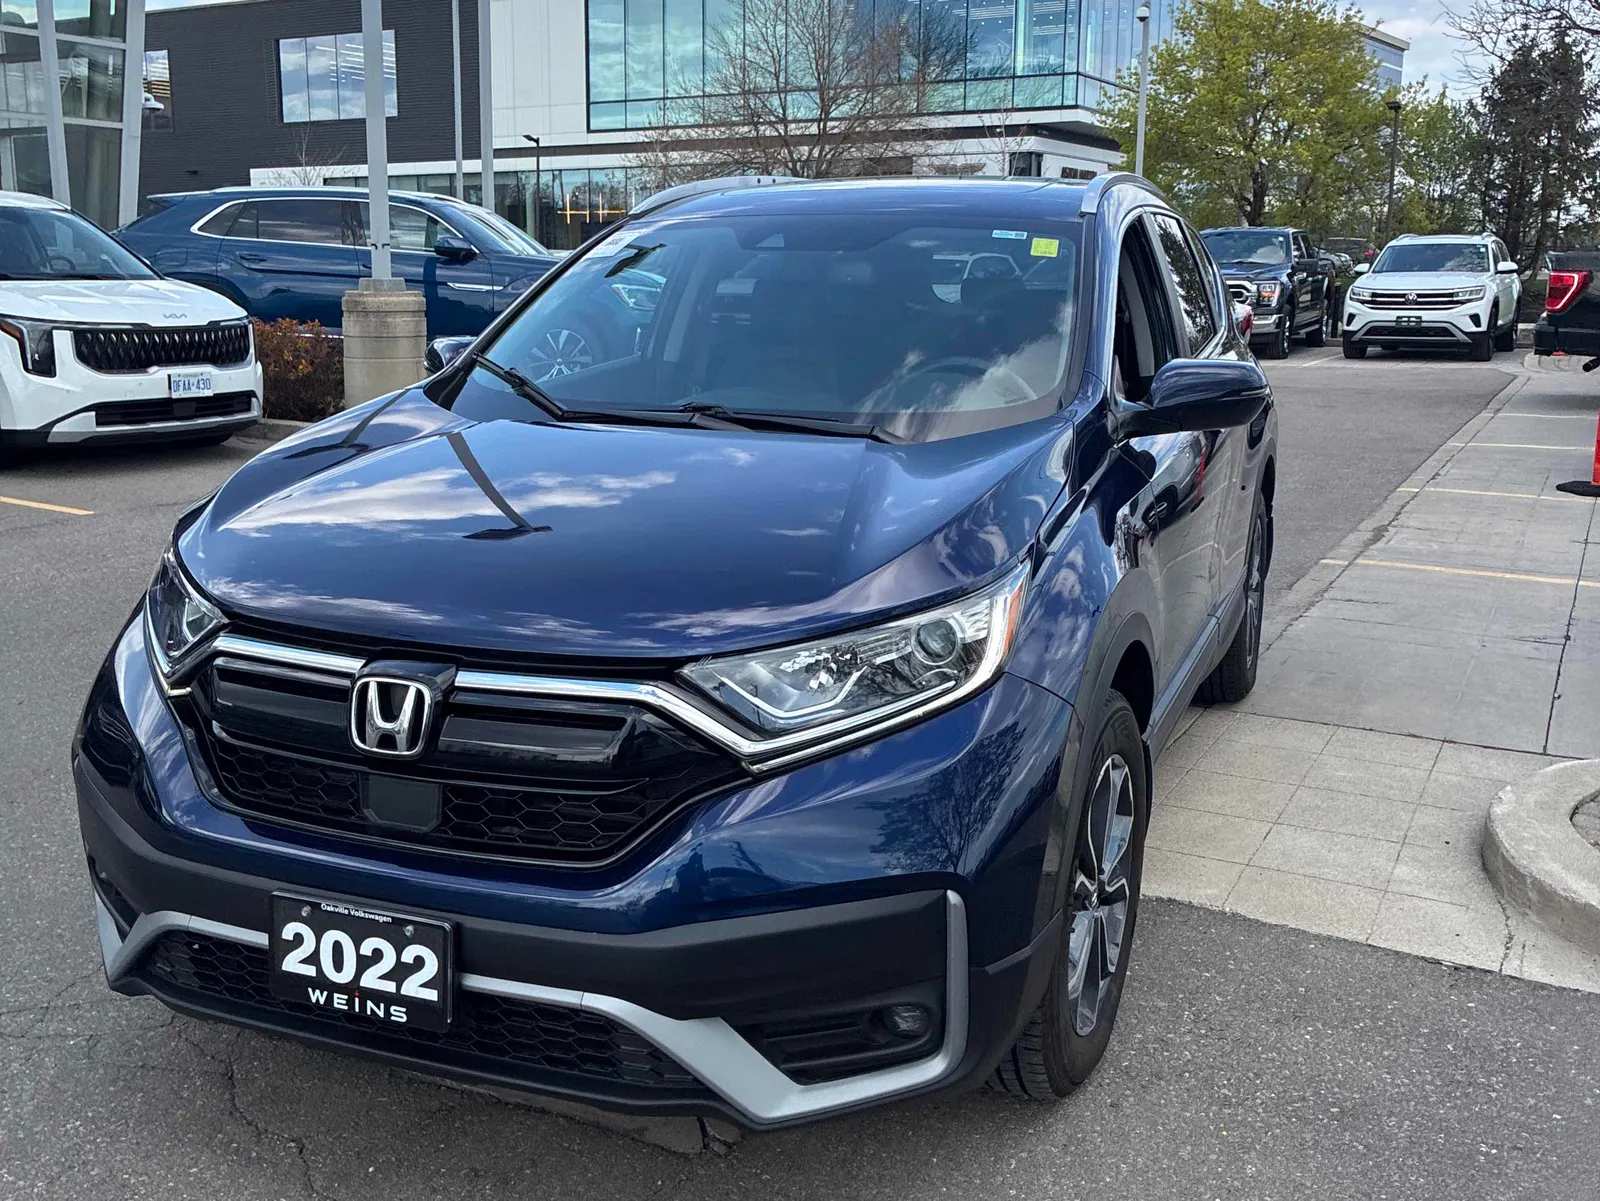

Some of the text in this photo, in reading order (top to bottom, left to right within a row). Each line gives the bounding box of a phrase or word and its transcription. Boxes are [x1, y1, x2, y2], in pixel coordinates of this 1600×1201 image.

[321, 903, 392, 923] Oakville Volkswagen
[281, 921, 439, 1002] 2022
